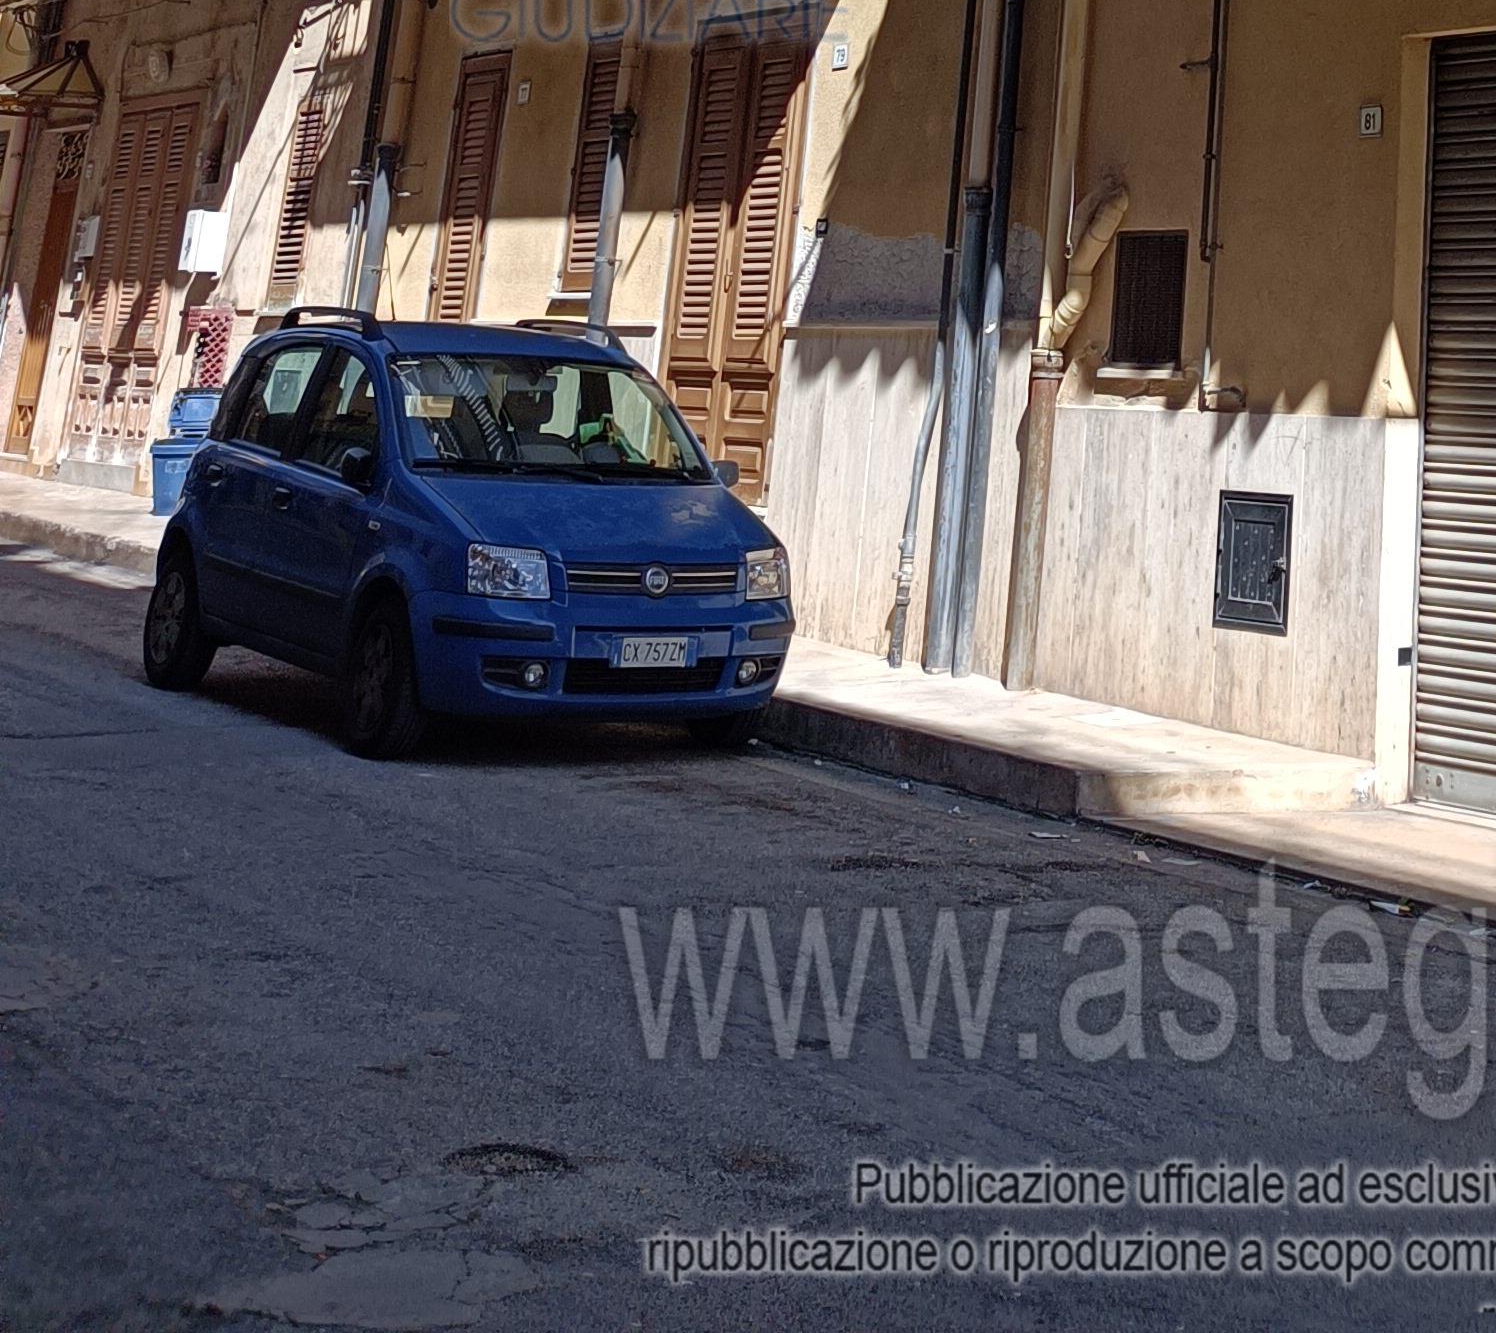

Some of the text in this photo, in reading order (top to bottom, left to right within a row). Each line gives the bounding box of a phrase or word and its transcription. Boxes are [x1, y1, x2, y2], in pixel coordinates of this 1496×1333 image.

[1364, 113, 1376, 130] 81
[623, 642, 686, 662] CX 757ZM
